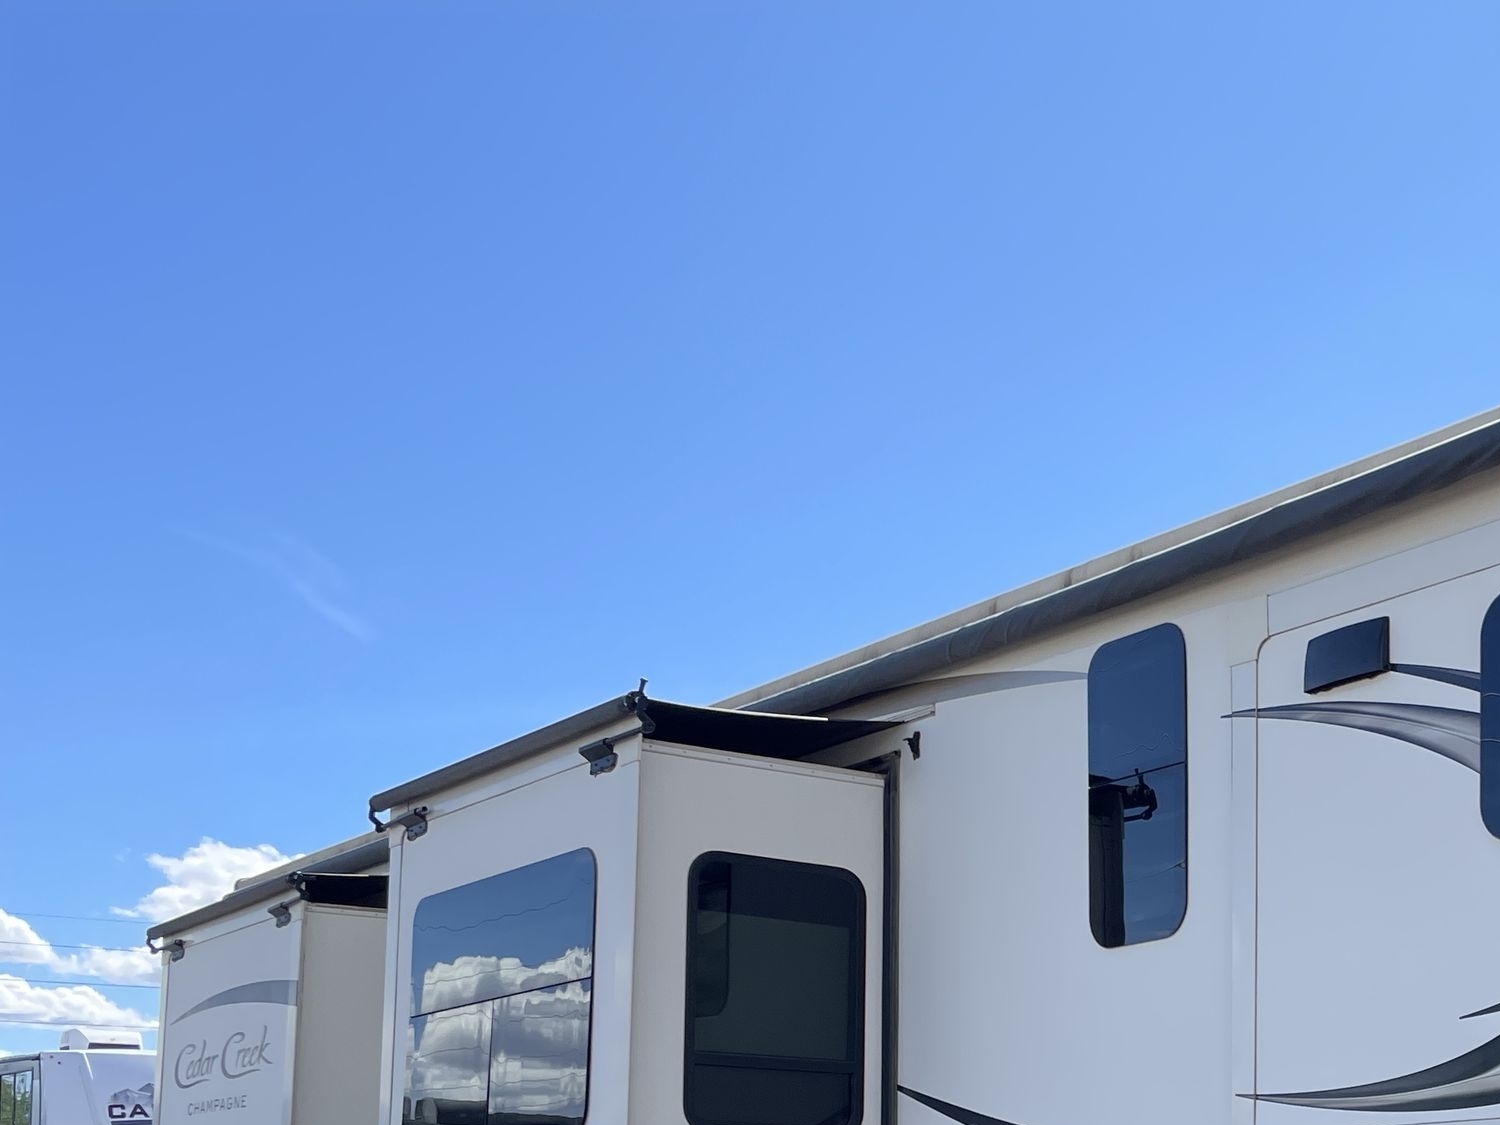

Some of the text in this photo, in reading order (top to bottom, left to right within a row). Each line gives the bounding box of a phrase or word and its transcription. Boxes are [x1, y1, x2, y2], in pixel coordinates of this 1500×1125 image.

[175, 1025, 273, 1089] Cedar Creek
[107, 1103, 153, 1119] CA
[187, 1094, 248, 1116] CHAMPAGNE
